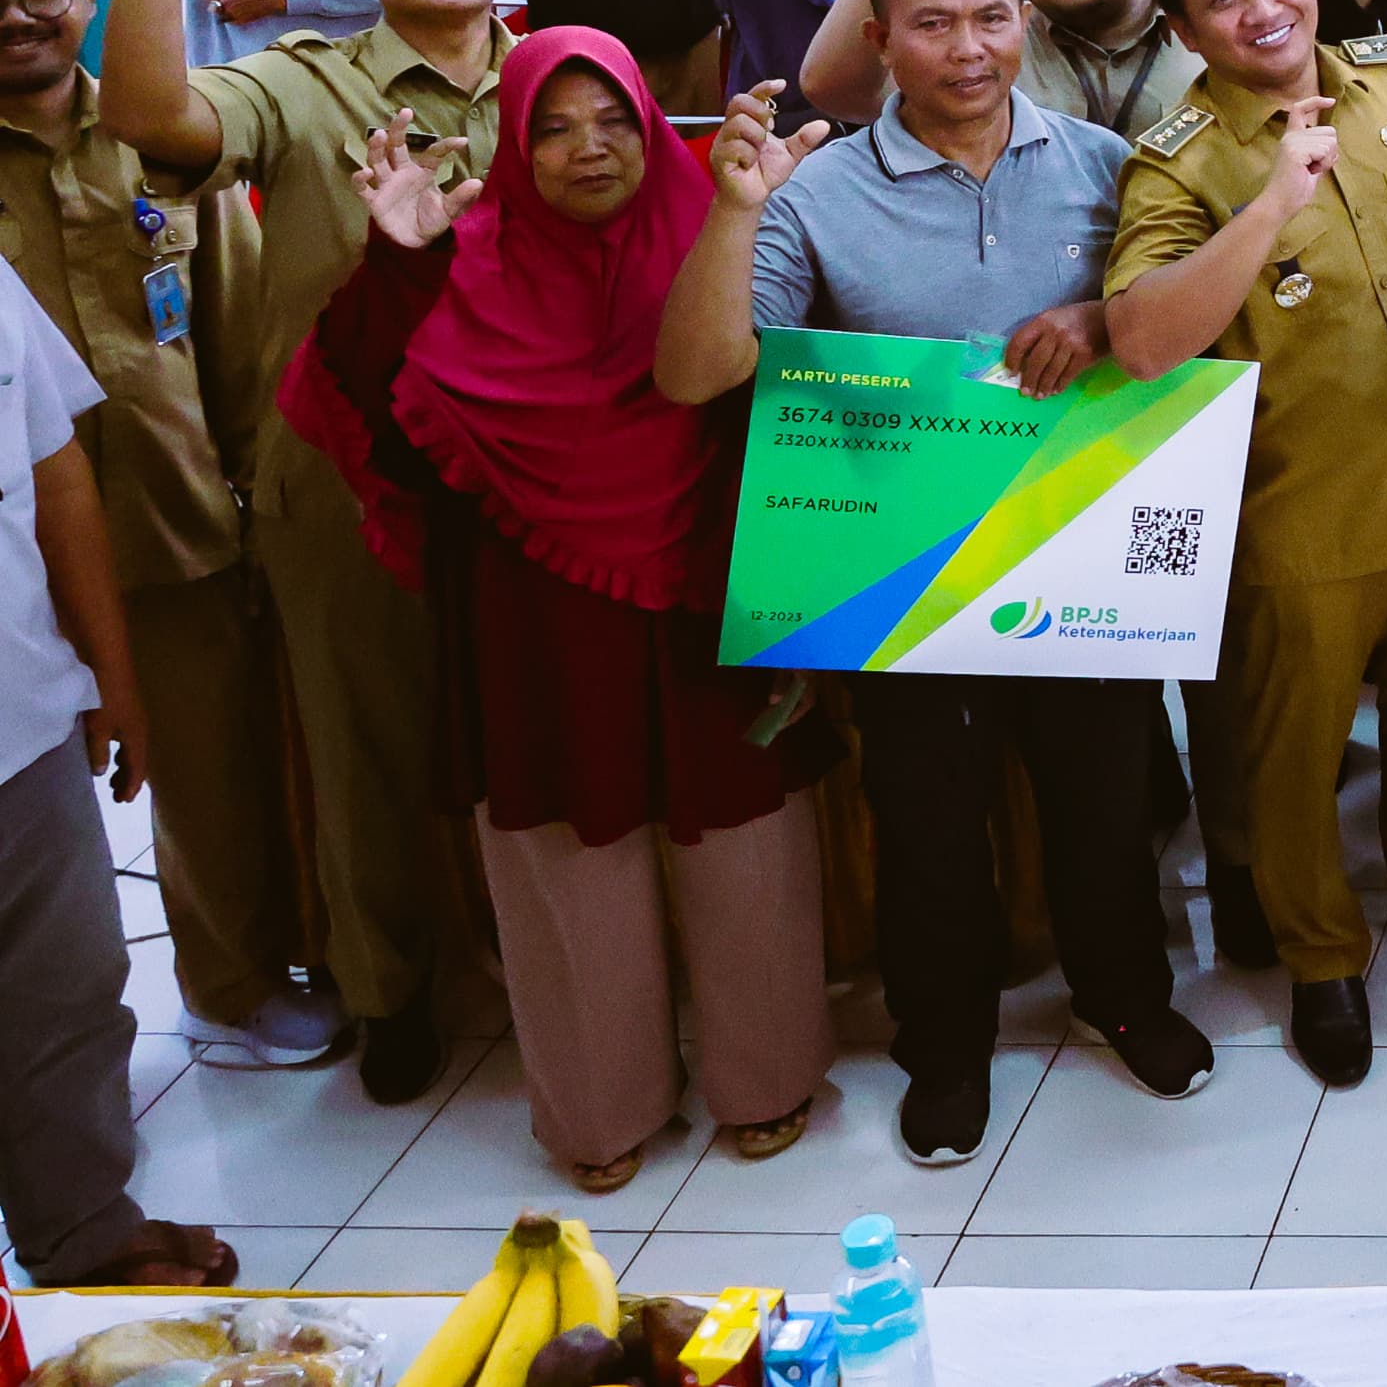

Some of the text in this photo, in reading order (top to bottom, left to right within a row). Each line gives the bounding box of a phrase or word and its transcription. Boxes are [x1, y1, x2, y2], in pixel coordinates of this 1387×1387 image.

[781, 369, 911, 389] KARTU PESERTA
[777, 406, 1040, 438] 3674 0309 XXXX XXXX
[765, 495, 878, 514] SAFARUDIN
[751, 610, 802, 622] 12-2023
[1060, 606, 1119, 624] BPJS
[1058, 625, 1197, 643] Ketenagakerjaan
